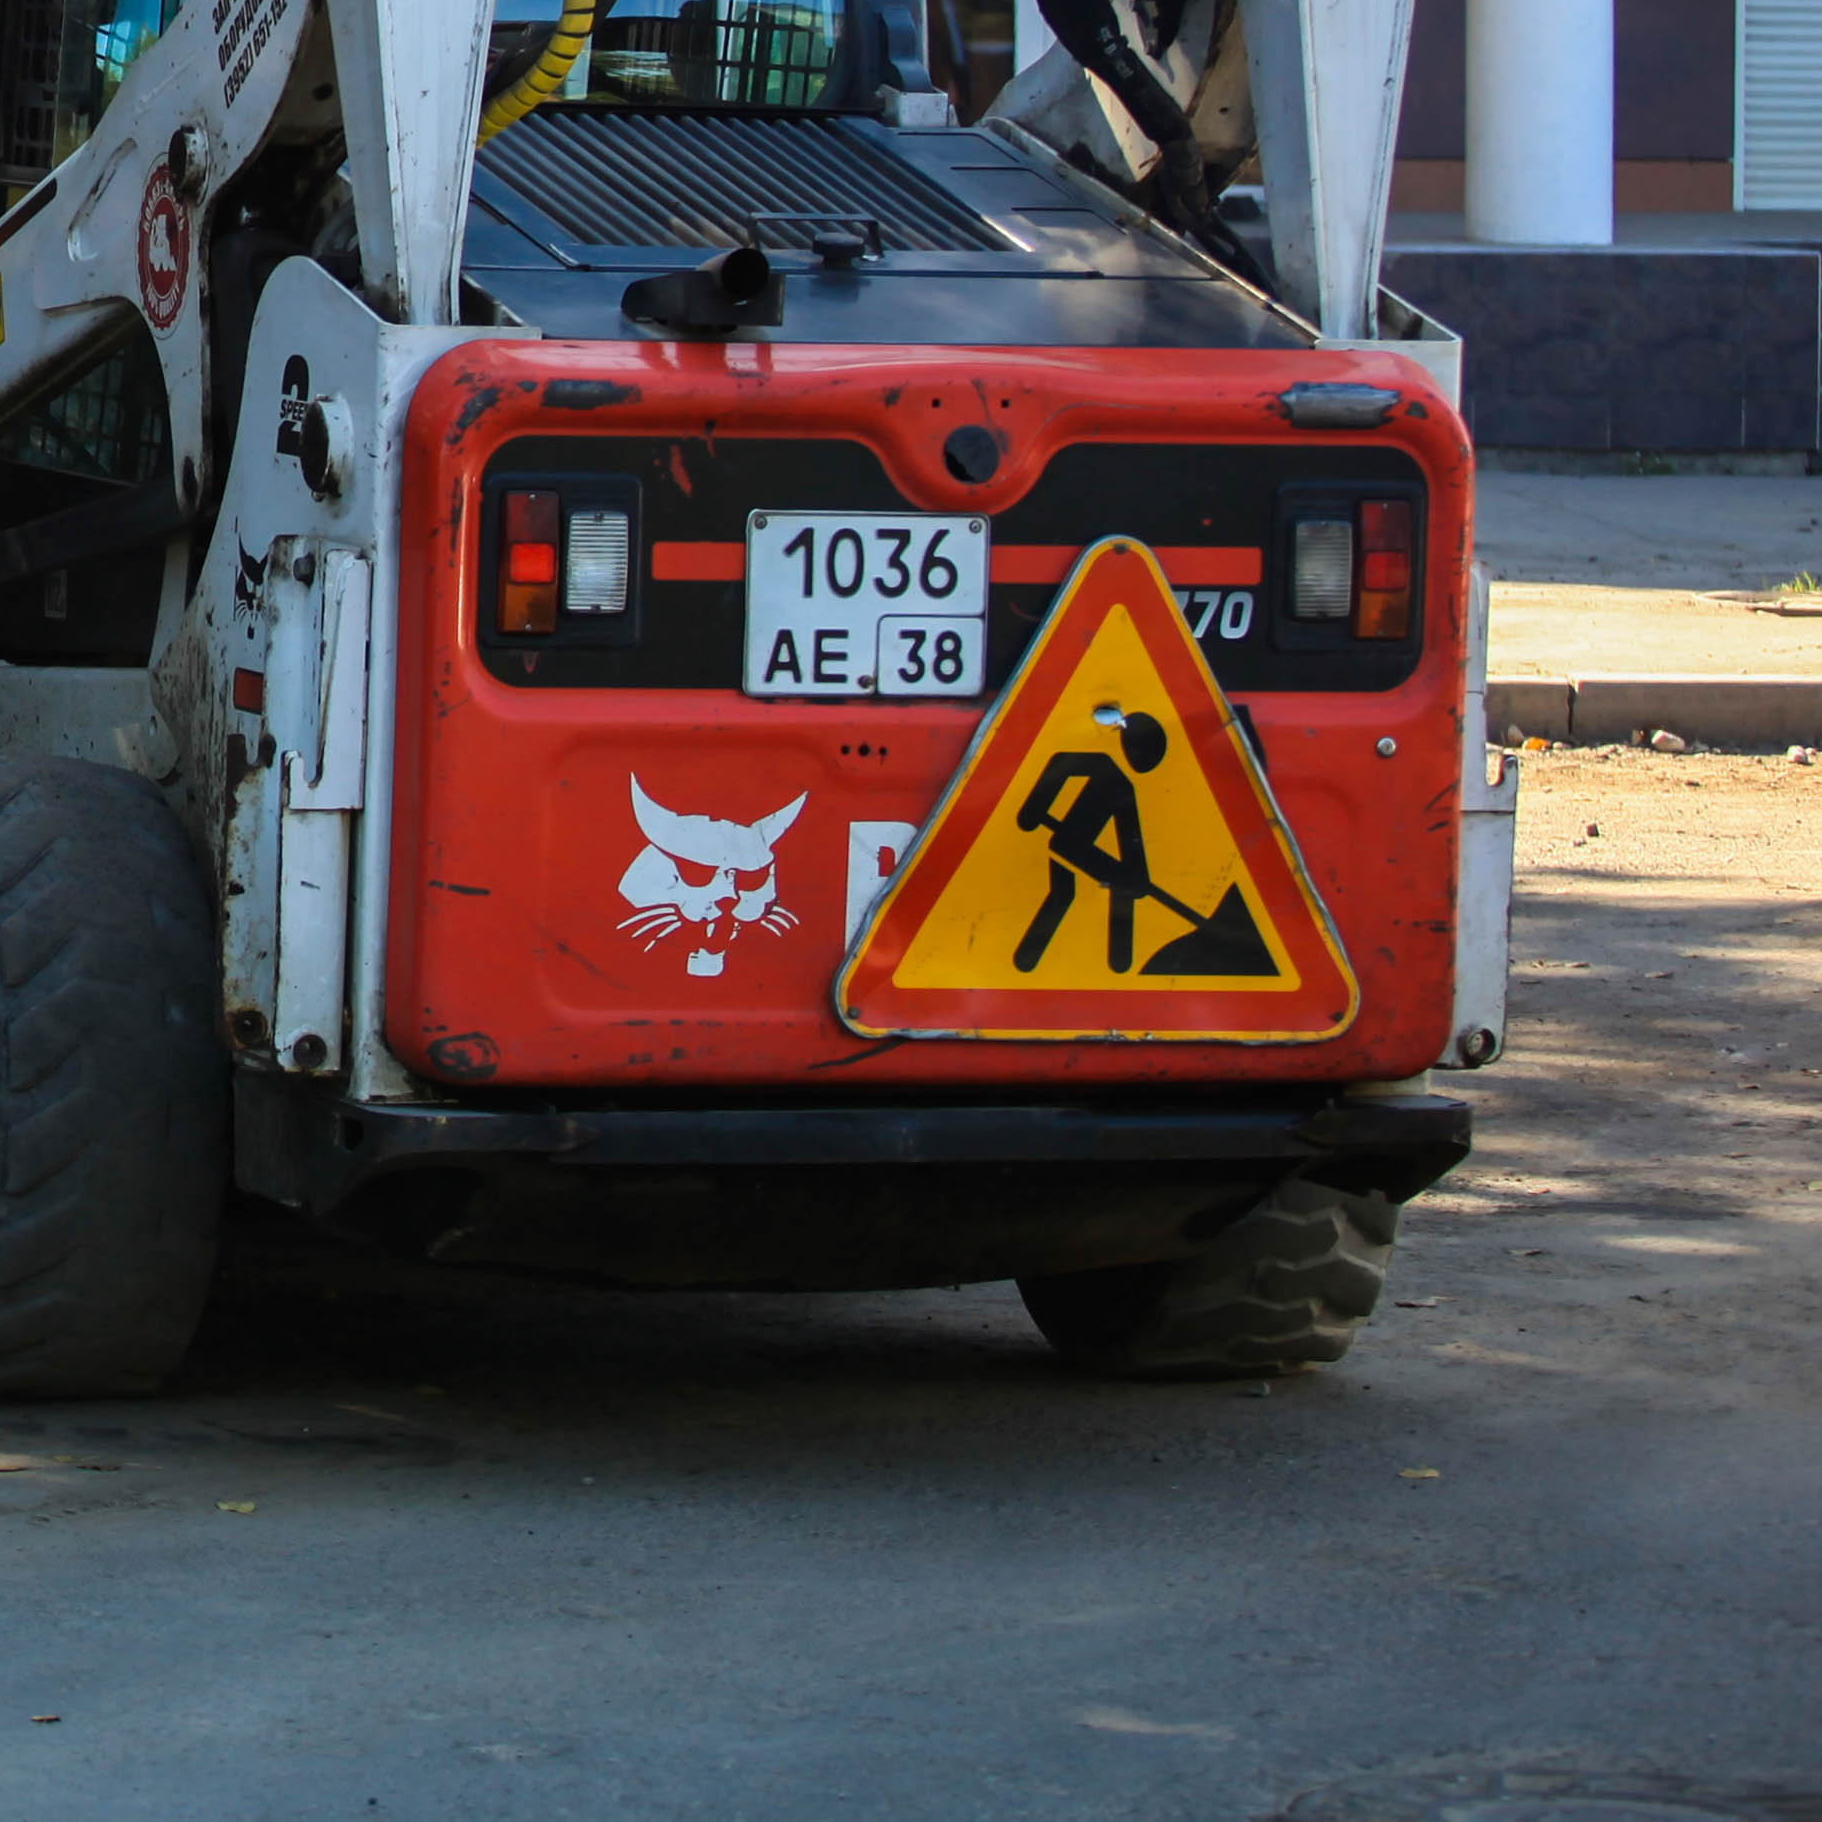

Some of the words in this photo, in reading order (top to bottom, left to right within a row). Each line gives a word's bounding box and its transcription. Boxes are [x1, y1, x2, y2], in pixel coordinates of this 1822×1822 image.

[224, 53, 254, 109] (3952)
[279, 398, 307, 422] SPEE
[782, 526, 959, 599] 1036
[764, 628, 850, 684] АЕ
[898, 629, 964, 685] 38
